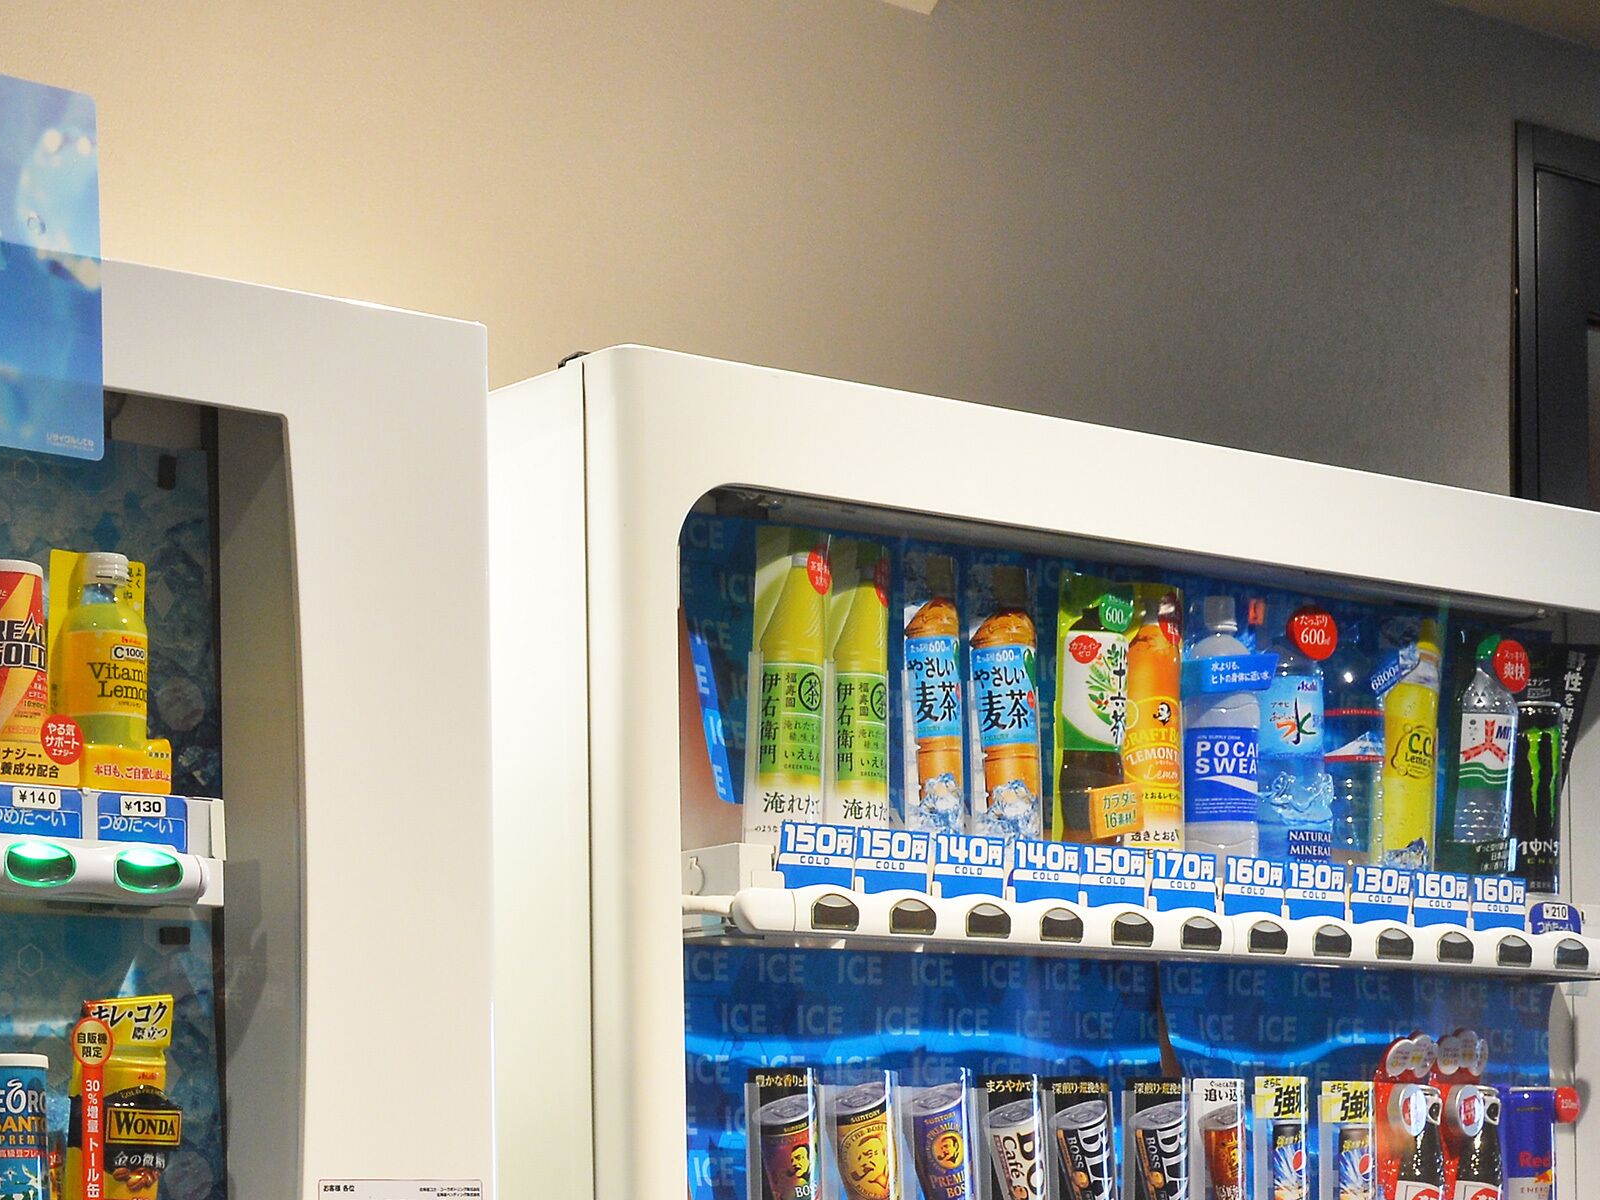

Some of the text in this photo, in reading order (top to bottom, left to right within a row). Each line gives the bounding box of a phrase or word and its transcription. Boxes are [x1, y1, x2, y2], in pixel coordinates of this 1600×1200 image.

[1300, 614, 1329, 627] たっぷり
[905, 656, 955, 680] やさしい
[1502, 663, 1527, 681] 爽快
[915, 681, 957, 724] 麦茶
[759, 669, 781, 766] 伊右衛門
[47, 722, 76, 736] やる気
[44, 734, 80, 749] サポート
[124, 799, 162, 814] ¥130
[1102, 793, 1138, 810] カラダに
[784, 822, 854, 856] 150円
[799, 855, 830, 866] COLD
[936, 834, 1003, 866] 140円
[1082, 847, 1145, 876] 150円
[1156, 850, 1214, 882] 170円
[1228, 858, 1283, 888] 160円
[1289, 862, 1344, 893] 130円
[1302, 890, 1326, 900] COLD
[76, 1031, 110, 1046] 自販機
[131, 1025, 168, 1041] 際立つ
[81, 1045, 105, 1060] 限定
[115, 1112, 178, 1138] WONDA
[1067, 1135, 1086, 1170] BOSS
